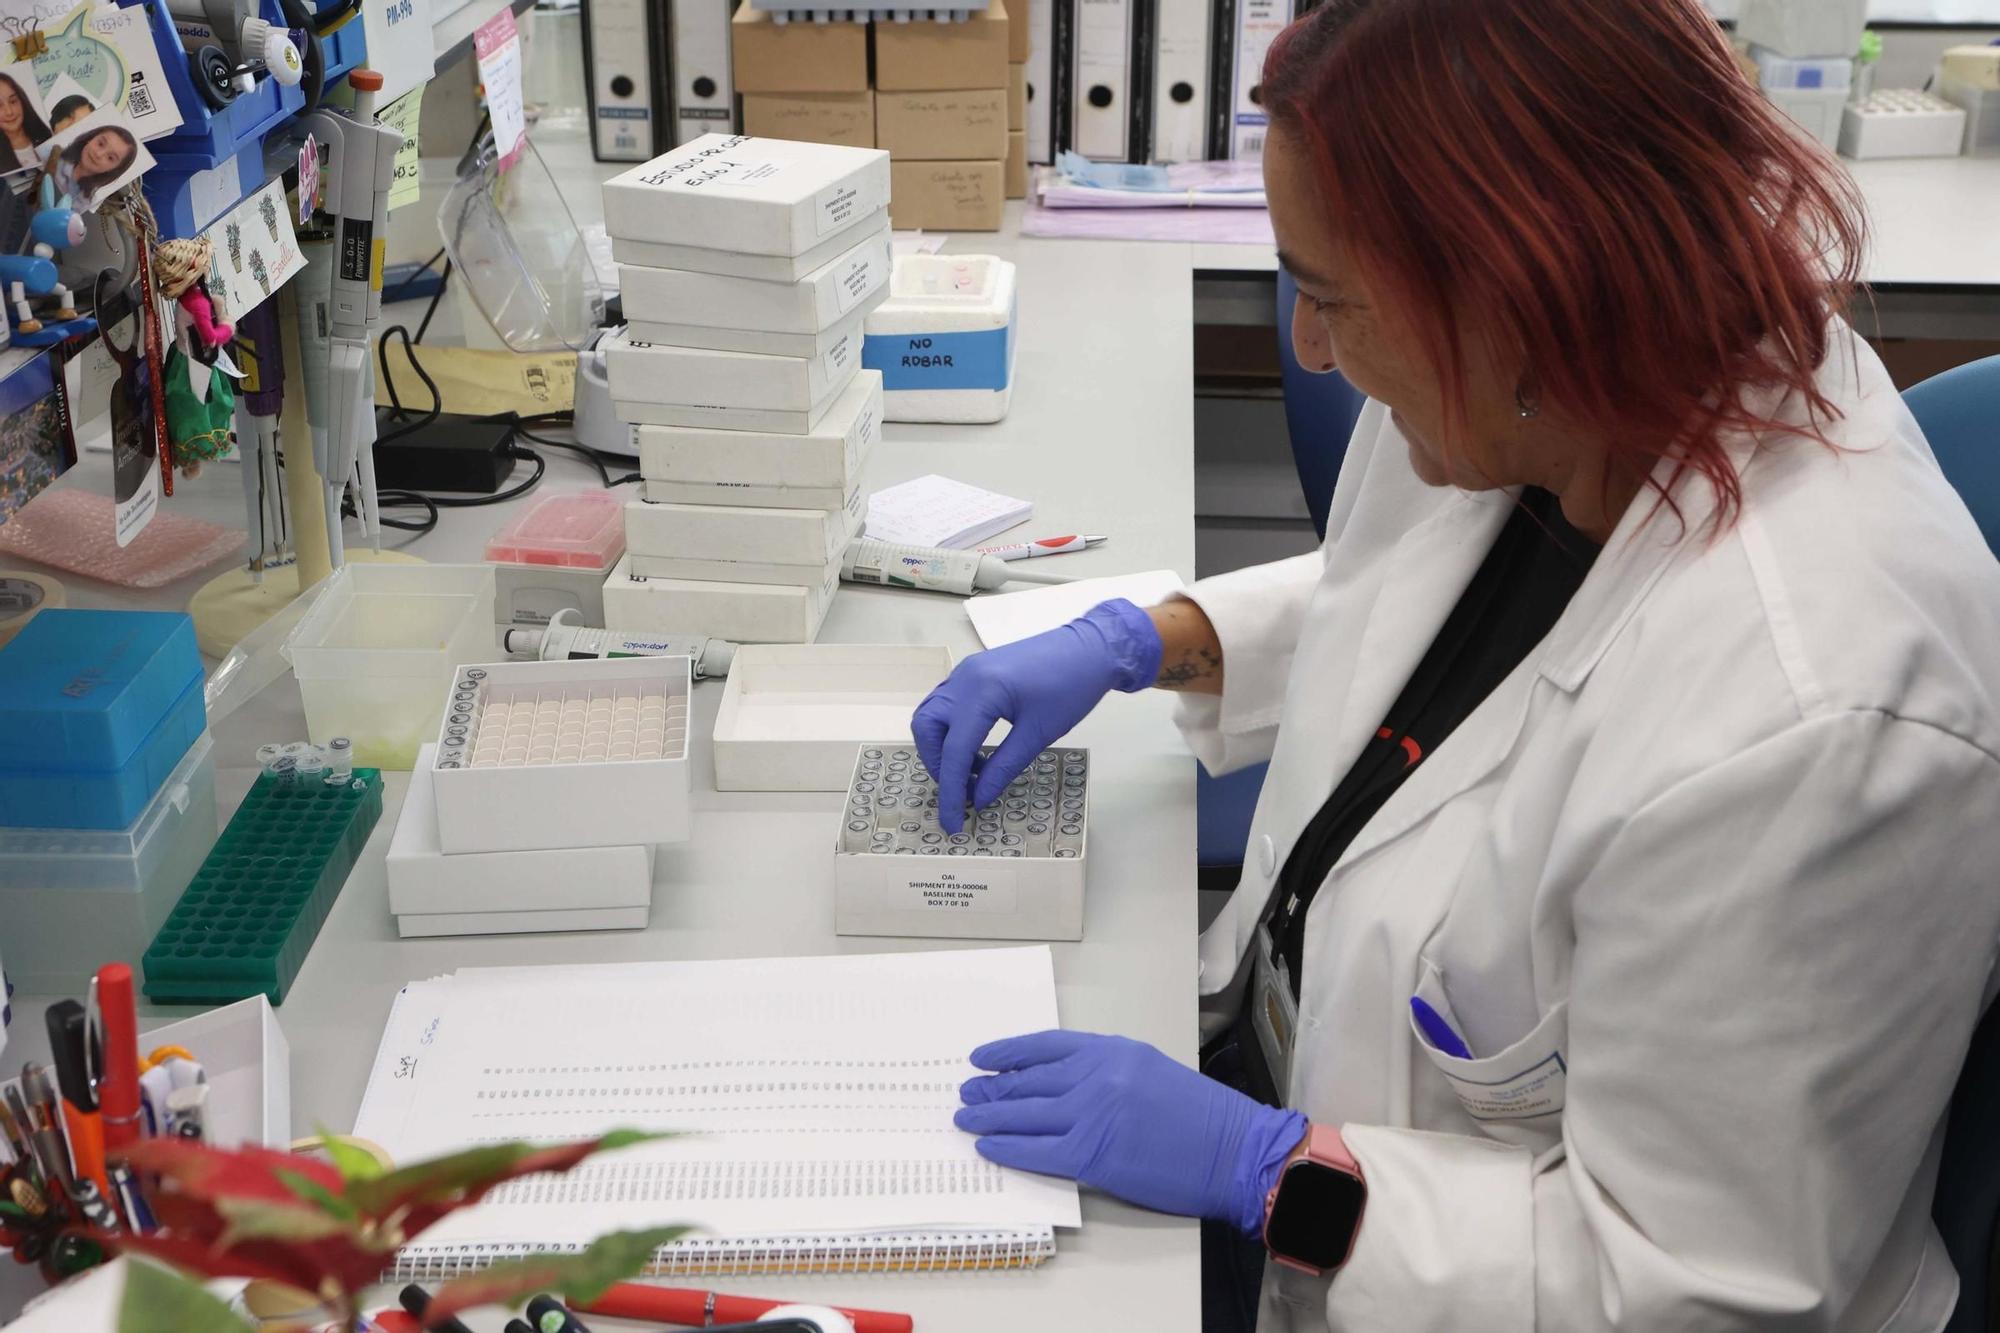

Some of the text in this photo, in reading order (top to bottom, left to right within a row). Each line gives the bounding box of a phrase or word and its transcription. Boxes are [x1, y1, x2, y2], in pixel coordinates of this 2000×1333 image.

[909, 338, 933, 350] NO
[56, 383, 68, 431] Toledo
[622, 641, 669, 651] eppendorf
